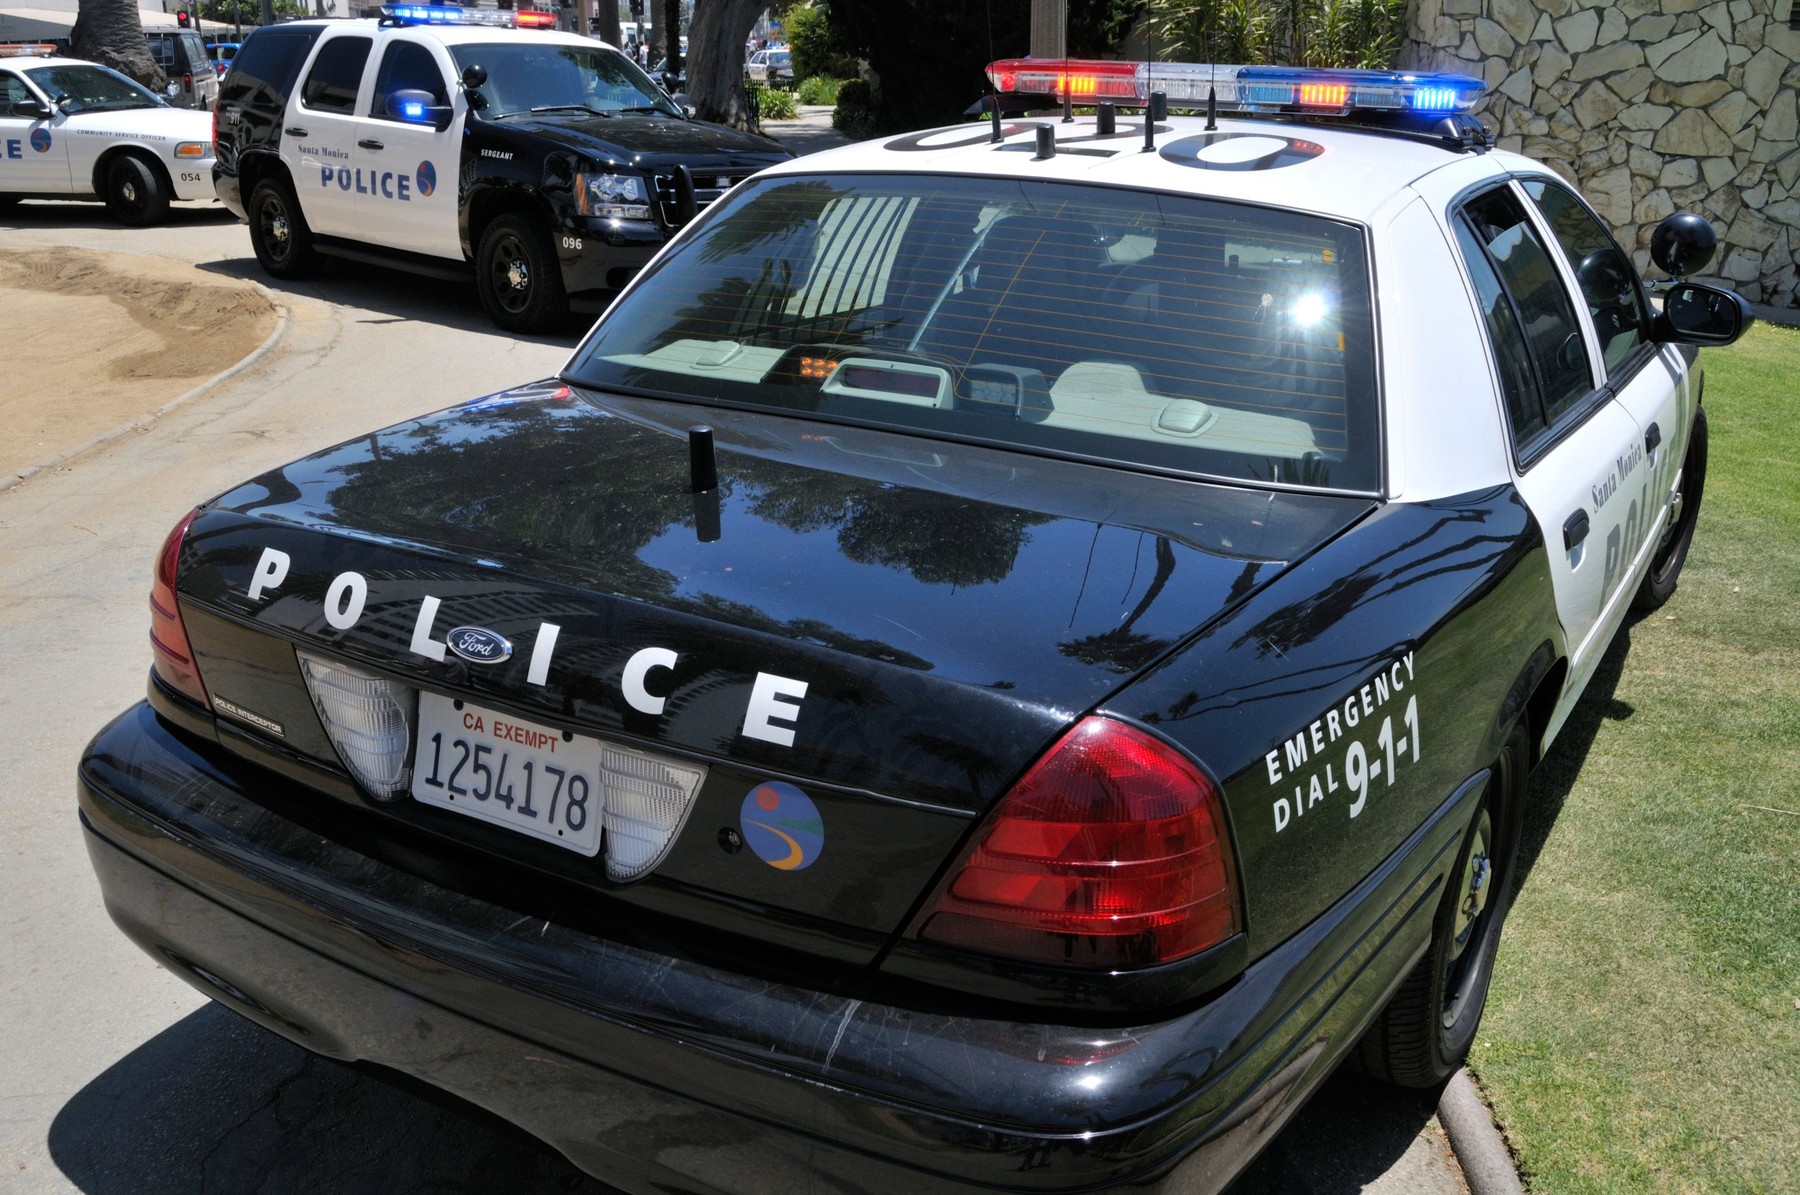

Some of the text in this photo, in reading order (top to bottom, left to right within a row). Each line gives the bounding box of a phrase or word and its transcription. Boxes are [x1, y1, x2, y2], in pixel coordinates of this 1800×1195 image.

[76, 129, 113, 137] COMMUNITY
[298, 144, 349, 159] Santa Monica
[481, 148, 514, 160] SERGEANT
[180, 172, 202, 182] 054
[321, 163, 411, 201] POLICE
[562, 236, 583, 250] 096
[1591, 442, 1643, 514] Santa Monica
[247, 547, 809, 748] POLICE
[458, 631, 495, 657] Ford
[214, 697, 282, 733] POLICE INTERCEPTOR
[463, 712, 559, 753] CA EXEMPT
[1265, 650, 1415, 786] EMERGENCY
[424, 731, 590, 832] 1254178
[1273, 694, 1420, 833] DIAL 9-1-1
